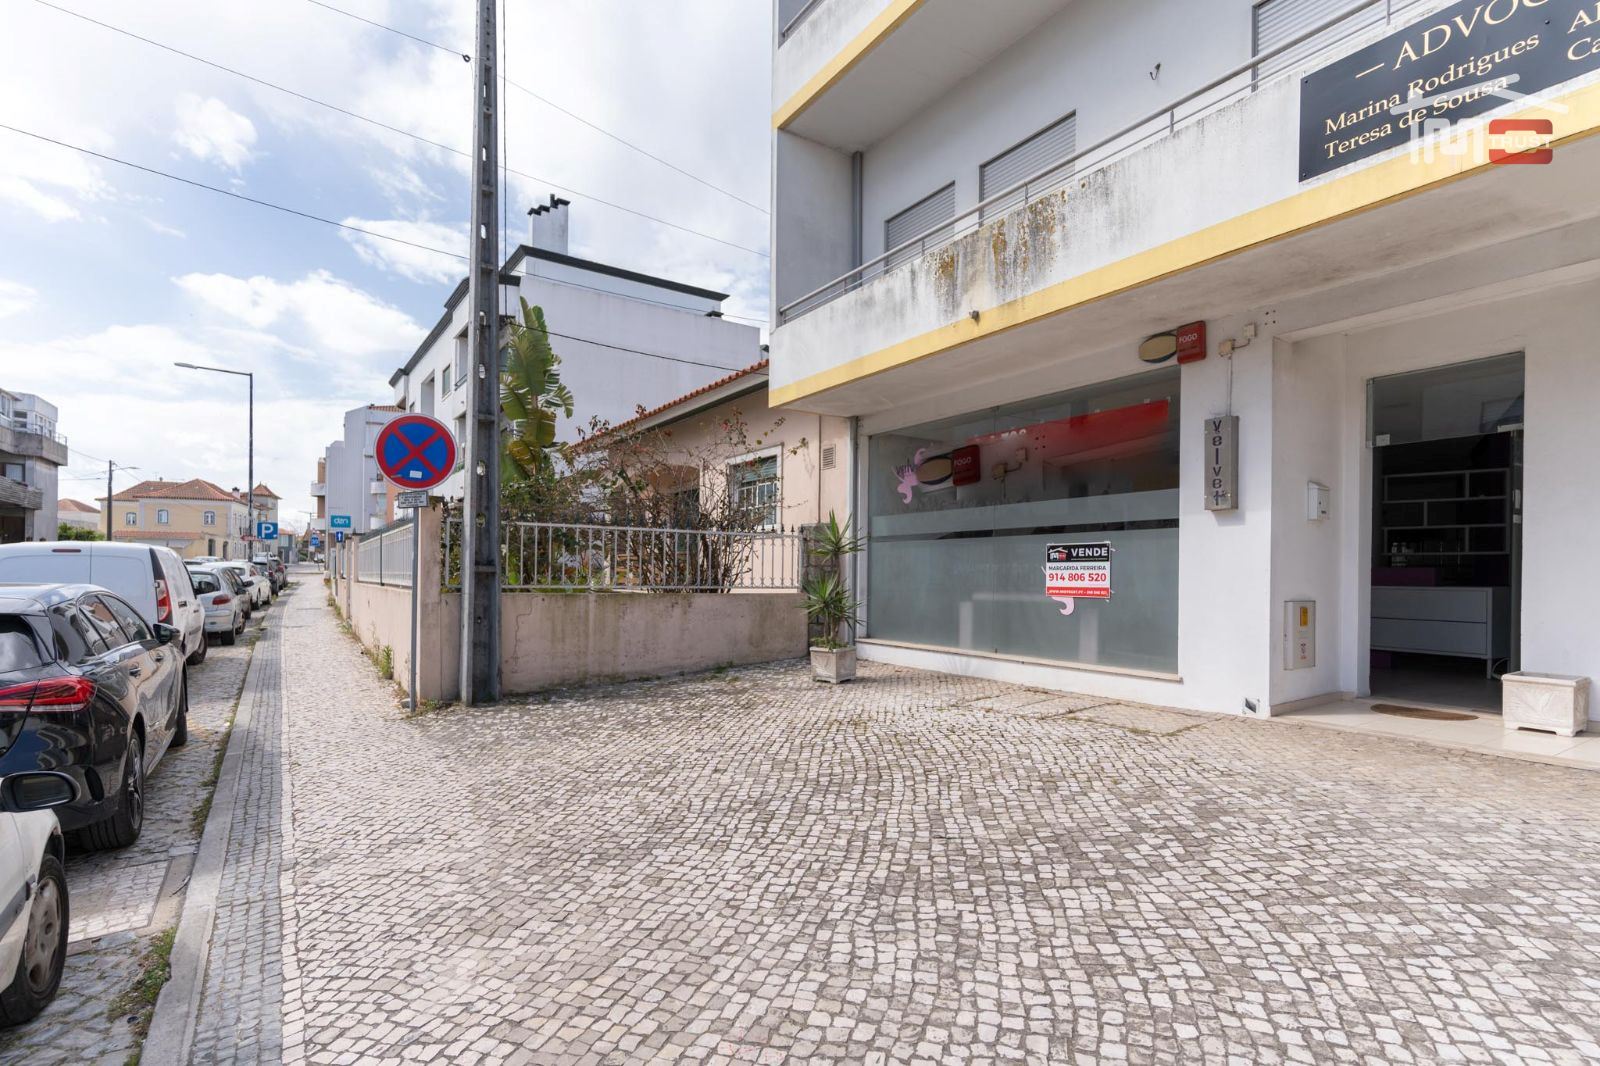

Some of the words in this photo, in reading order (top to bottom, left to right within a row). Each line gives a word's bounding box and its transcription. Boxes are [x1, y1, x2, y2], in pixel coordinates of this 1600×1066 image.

[1393, 0, 1548, 71] ADVO
[1324, 94, 1401, 136] Marina
[1407, 34, 1541, 98] Rodrigues
[1324, 122, 1392, 160] Teresa
[1398, 106, 1427, 129] de
[1432, 76, 1509, 116] Sousa
[261, 523, 274, 538] P
[1071, 547, 1108, 557] VENDE
[1048, 573, 1065, 582] 914
[1068, 573, 1086, 582] 806
[1088, 573, 1107, 582] 520
